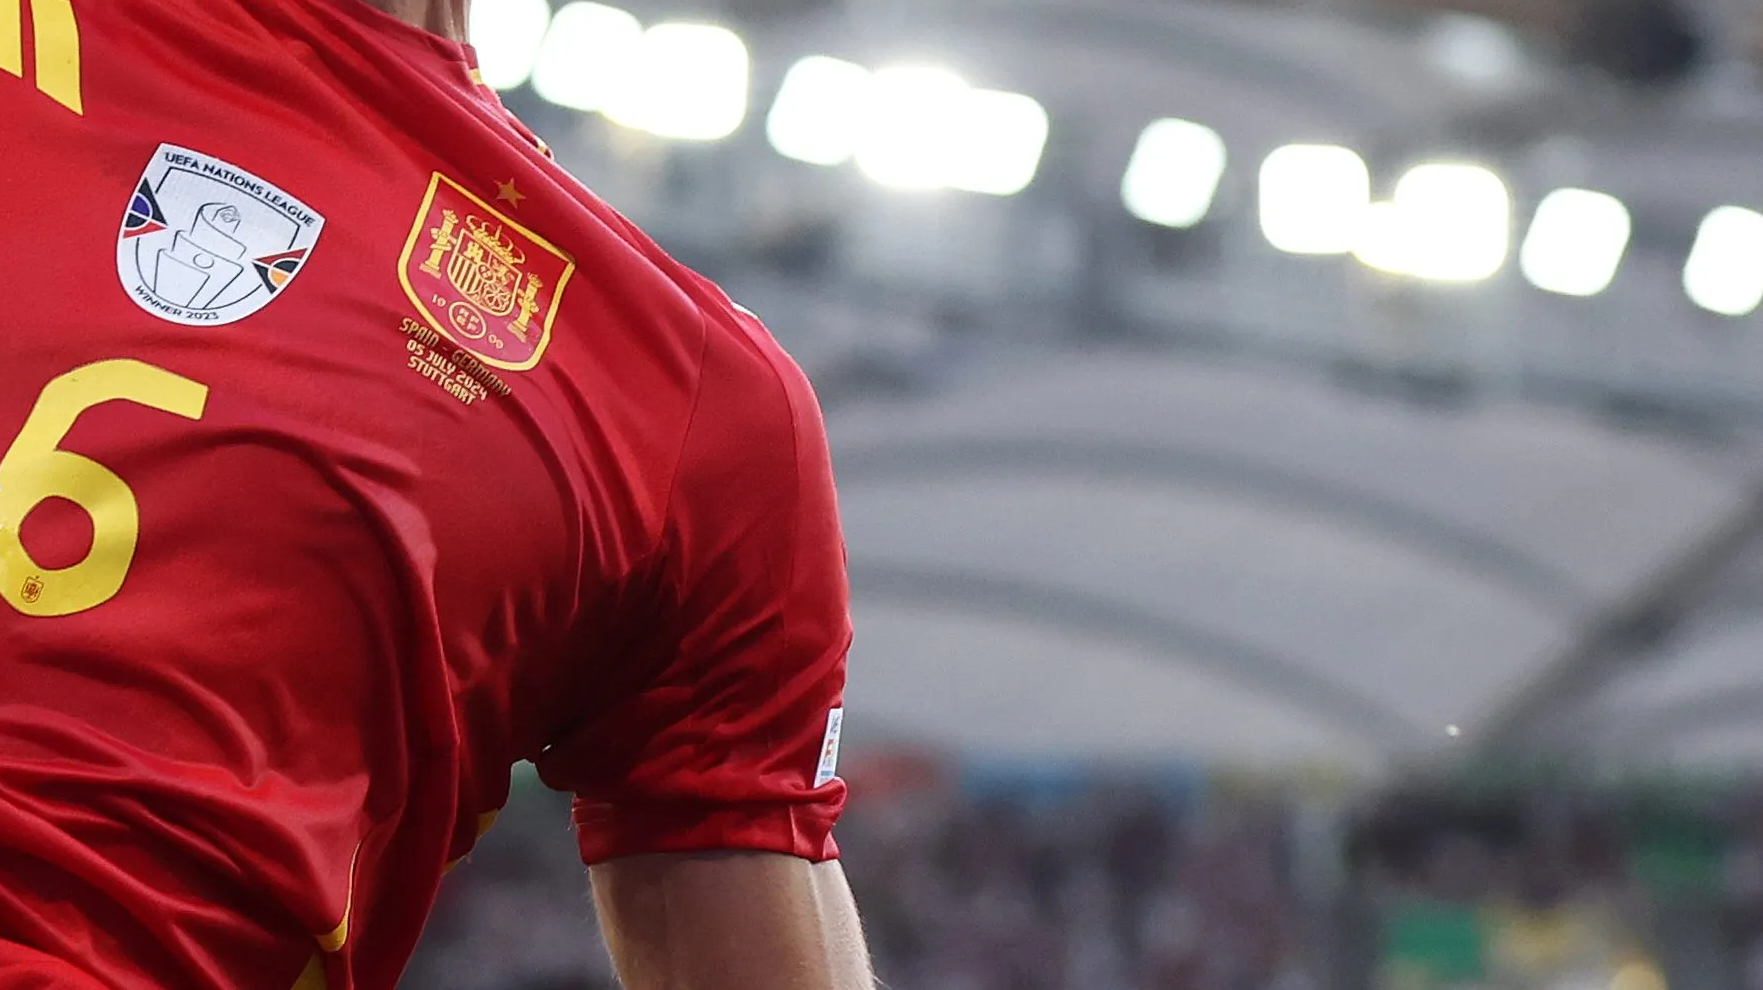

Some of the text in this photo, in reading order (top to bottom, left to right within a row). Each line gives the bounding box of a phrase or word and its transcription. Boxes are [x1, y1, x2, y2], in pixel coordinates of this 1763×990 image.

[165, 151, 316, 227] UEFA NATIONS LEAGUE
[135, 285, 219, 320] WINNER 2023
[399, 317, 440, 348] SPAIN
[451, 349, 512, 397] GERMANY
[406, 338, 488, 401] 05 JULY 2024
[407, 355, 476, 405] STUTTGART
